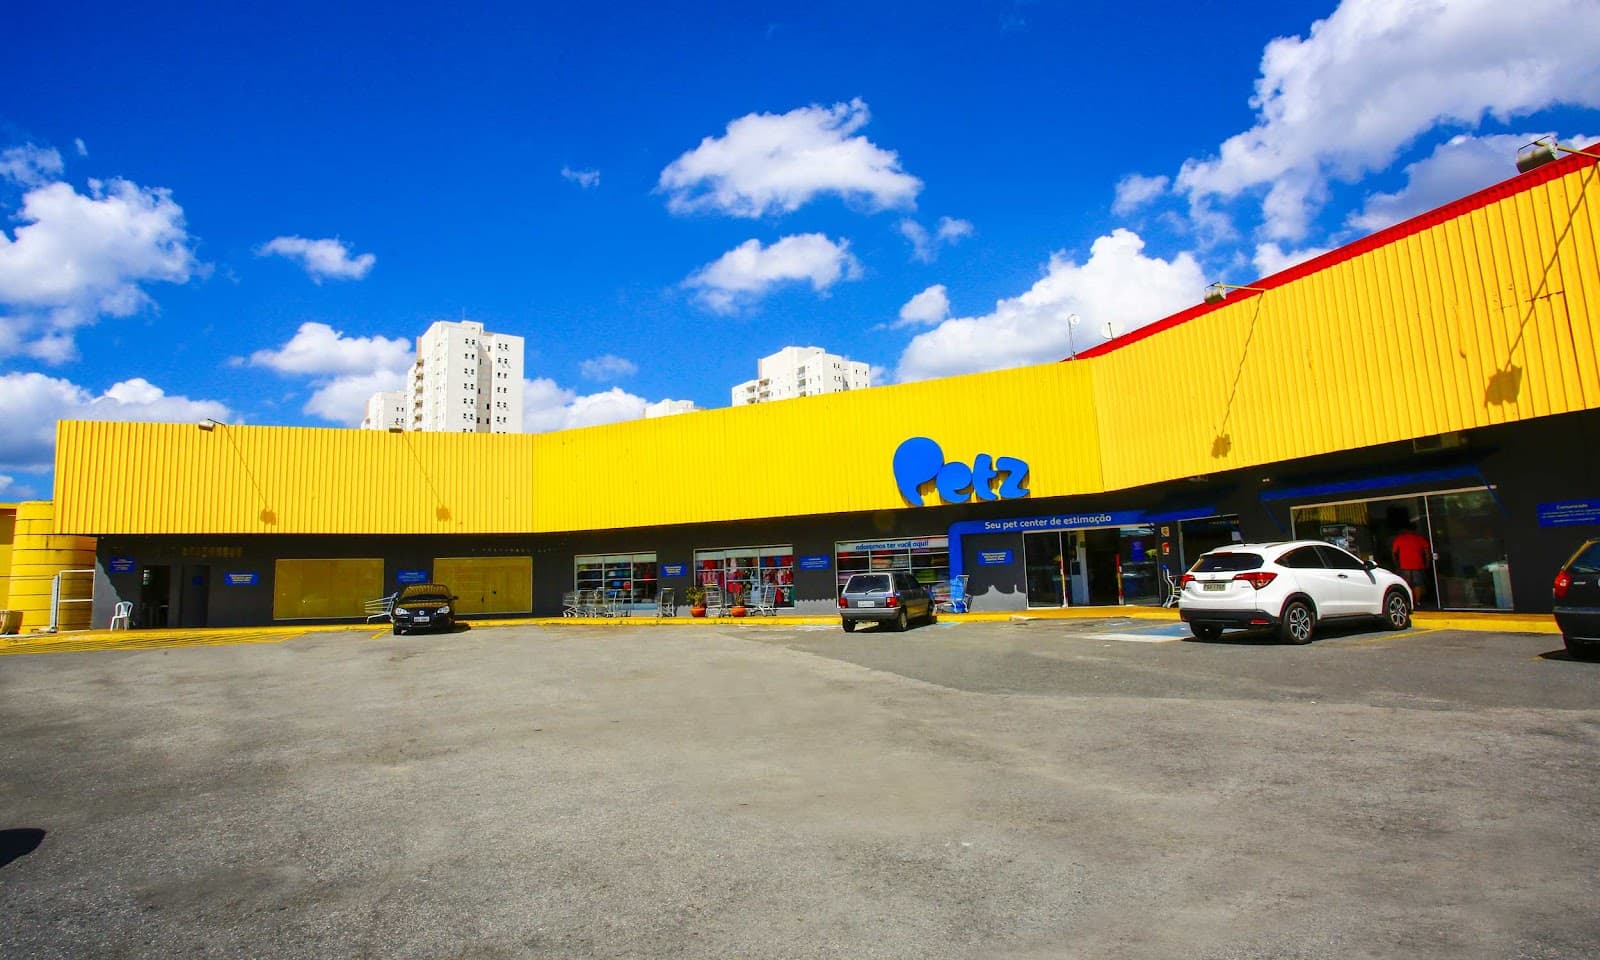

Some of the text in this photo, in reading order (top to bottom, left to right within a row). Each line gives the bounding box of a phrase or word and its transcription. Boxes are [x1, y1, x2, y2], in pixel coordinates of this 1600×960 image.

[893, 437, 1029, 506] Petz
[985, 514, 1112, 531] Seu pet center de estimação
